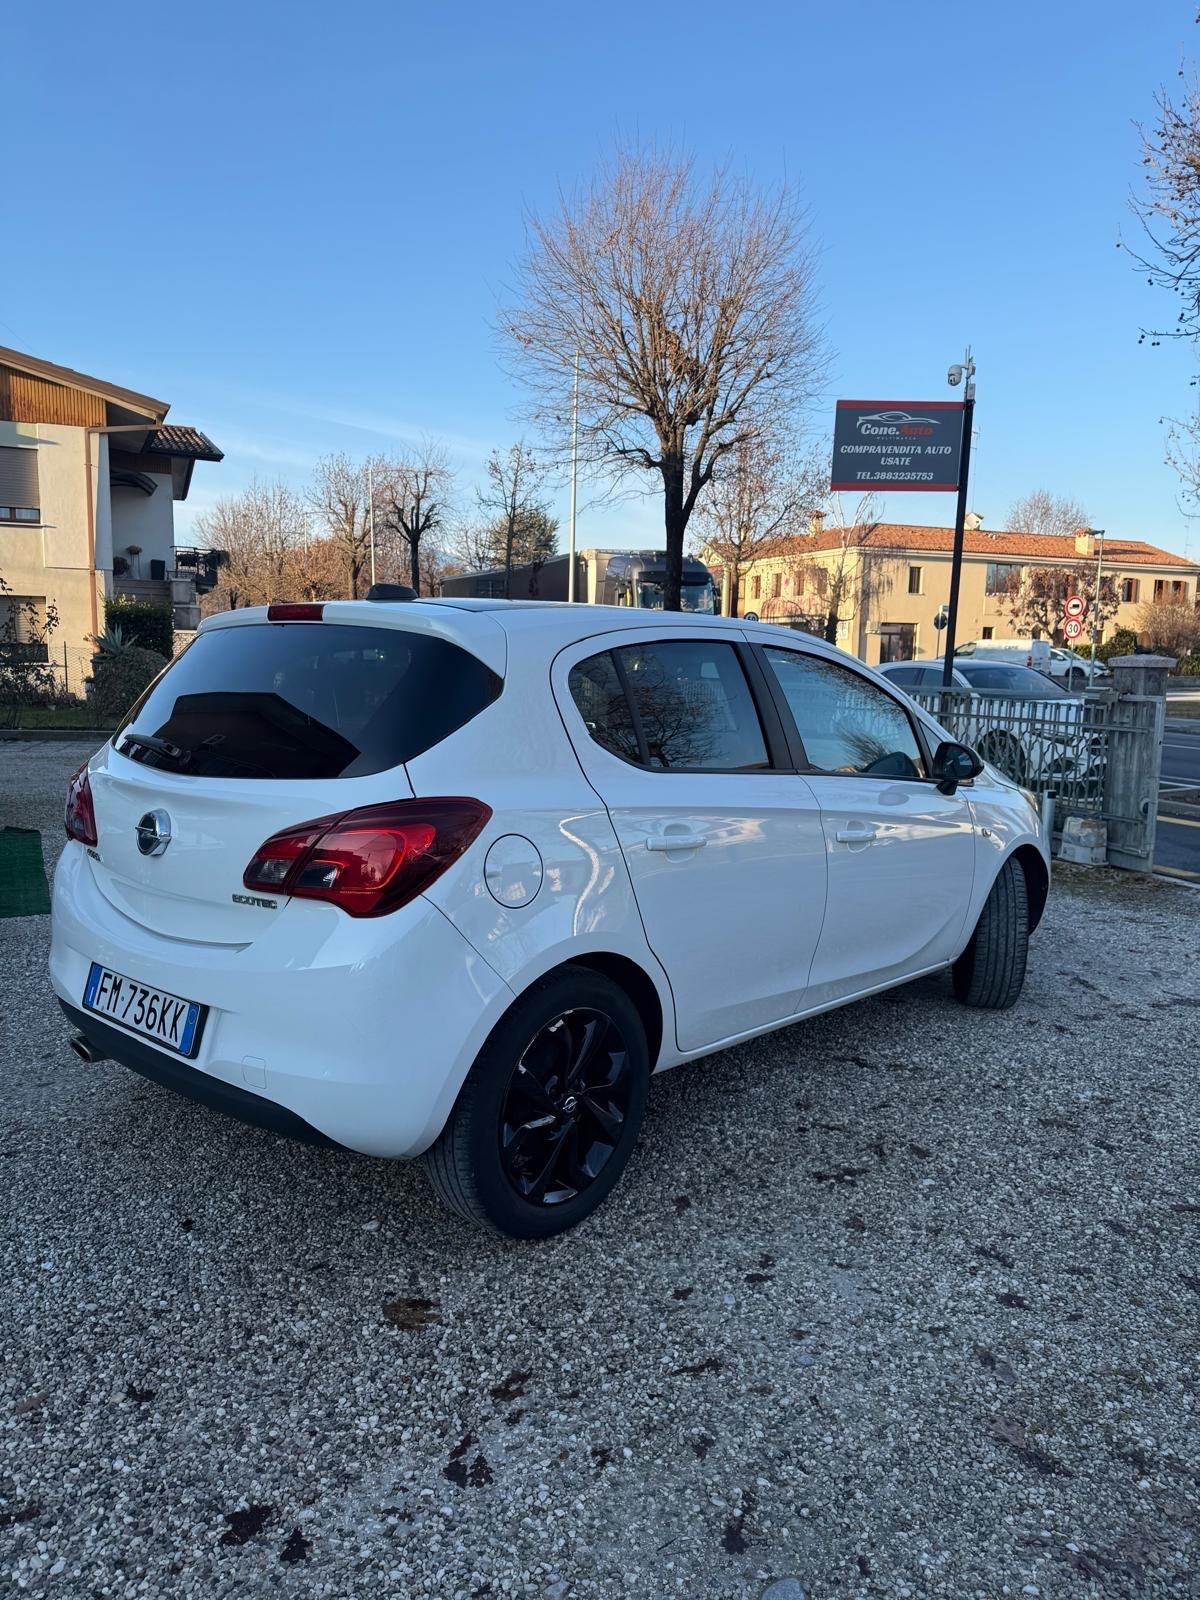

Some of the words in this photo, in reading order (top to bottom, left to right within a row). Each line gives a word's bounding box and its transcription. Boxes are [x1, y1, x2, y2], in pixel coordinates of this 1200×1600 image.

[840, 445, 921, 454] COMPRAVENDITA
[924, 446, 952, 455] AUTO
[880, 457, 911, 466] USATE
[1068, 624, 1078, 633] 30
